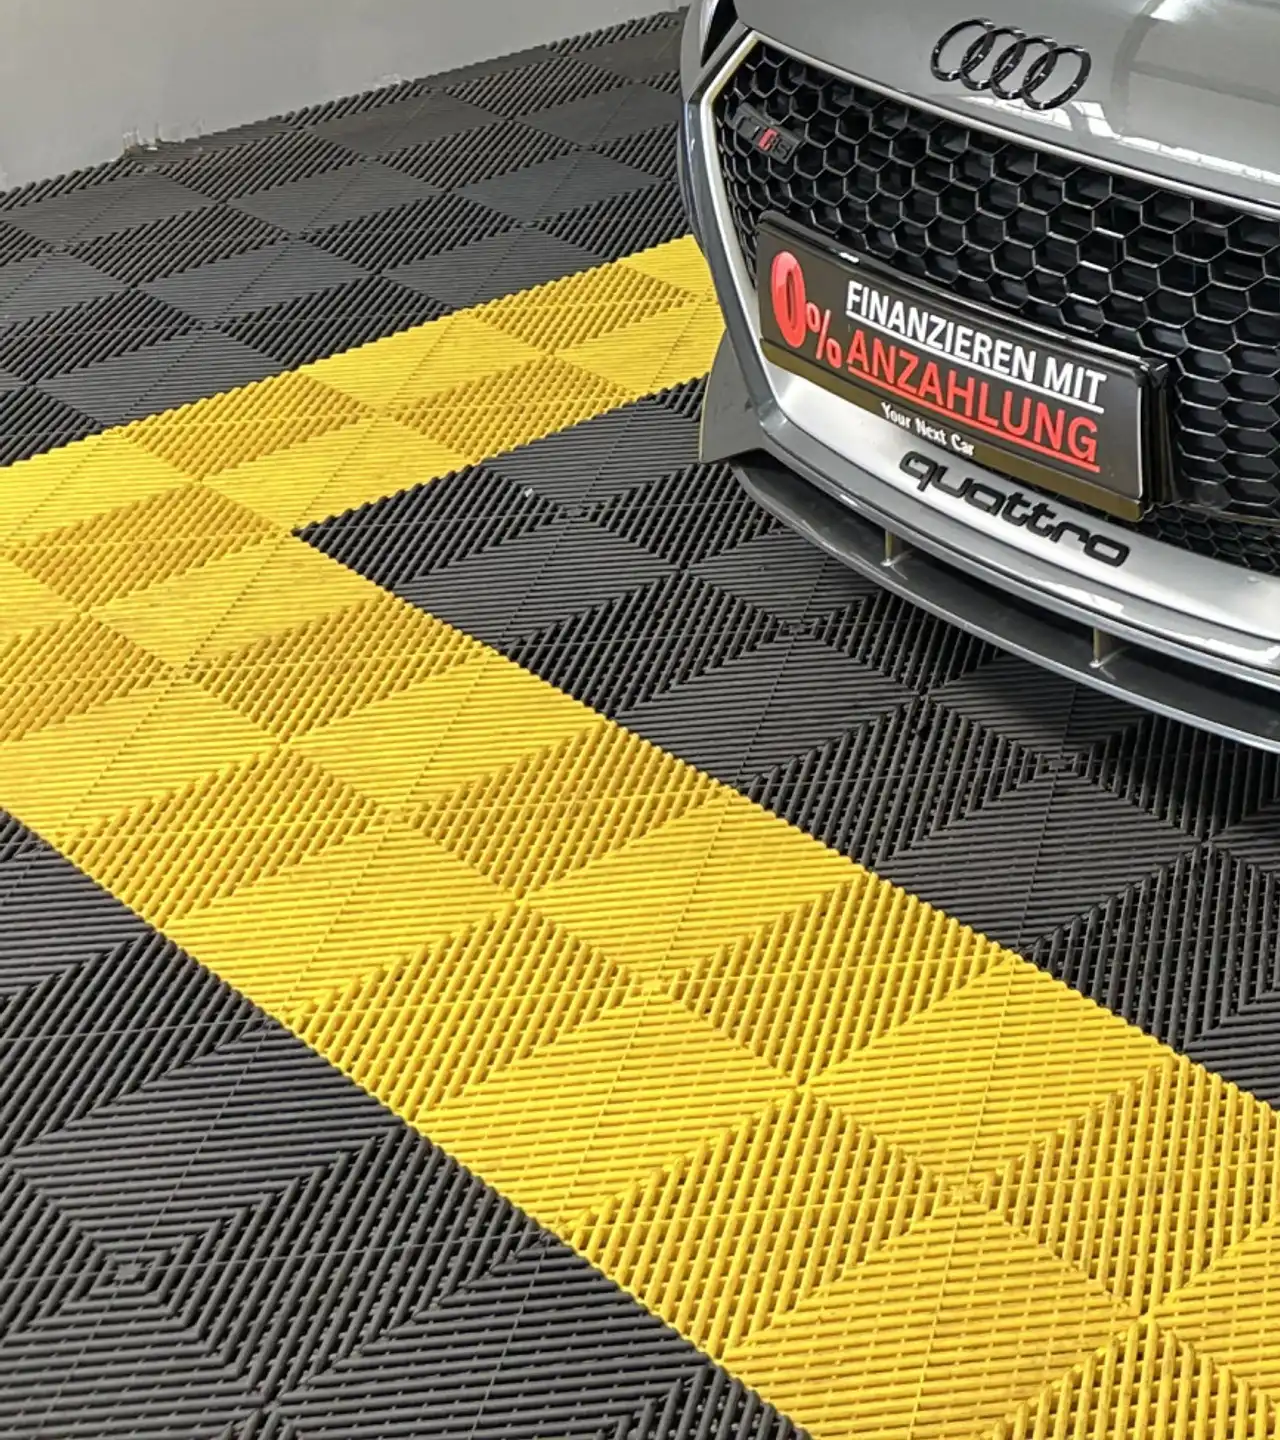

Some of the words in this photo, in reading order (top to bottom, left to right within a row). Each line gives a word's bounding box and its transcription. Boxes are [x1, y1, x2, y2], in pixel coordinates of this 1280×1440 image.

[770, 249, 843, 369] 0%
[847, 328, 1098, 464] ANZAHLUNG
[846, 280, 1036, 382] FINANZIEREN
[1043, 356, 1107, 405] MIT
[880, 401, 912, 430] Your
[914, 417, 948, 446] Next
[950, 432, 975, 458] Car
[899, 450, 1130, 567] quattro
